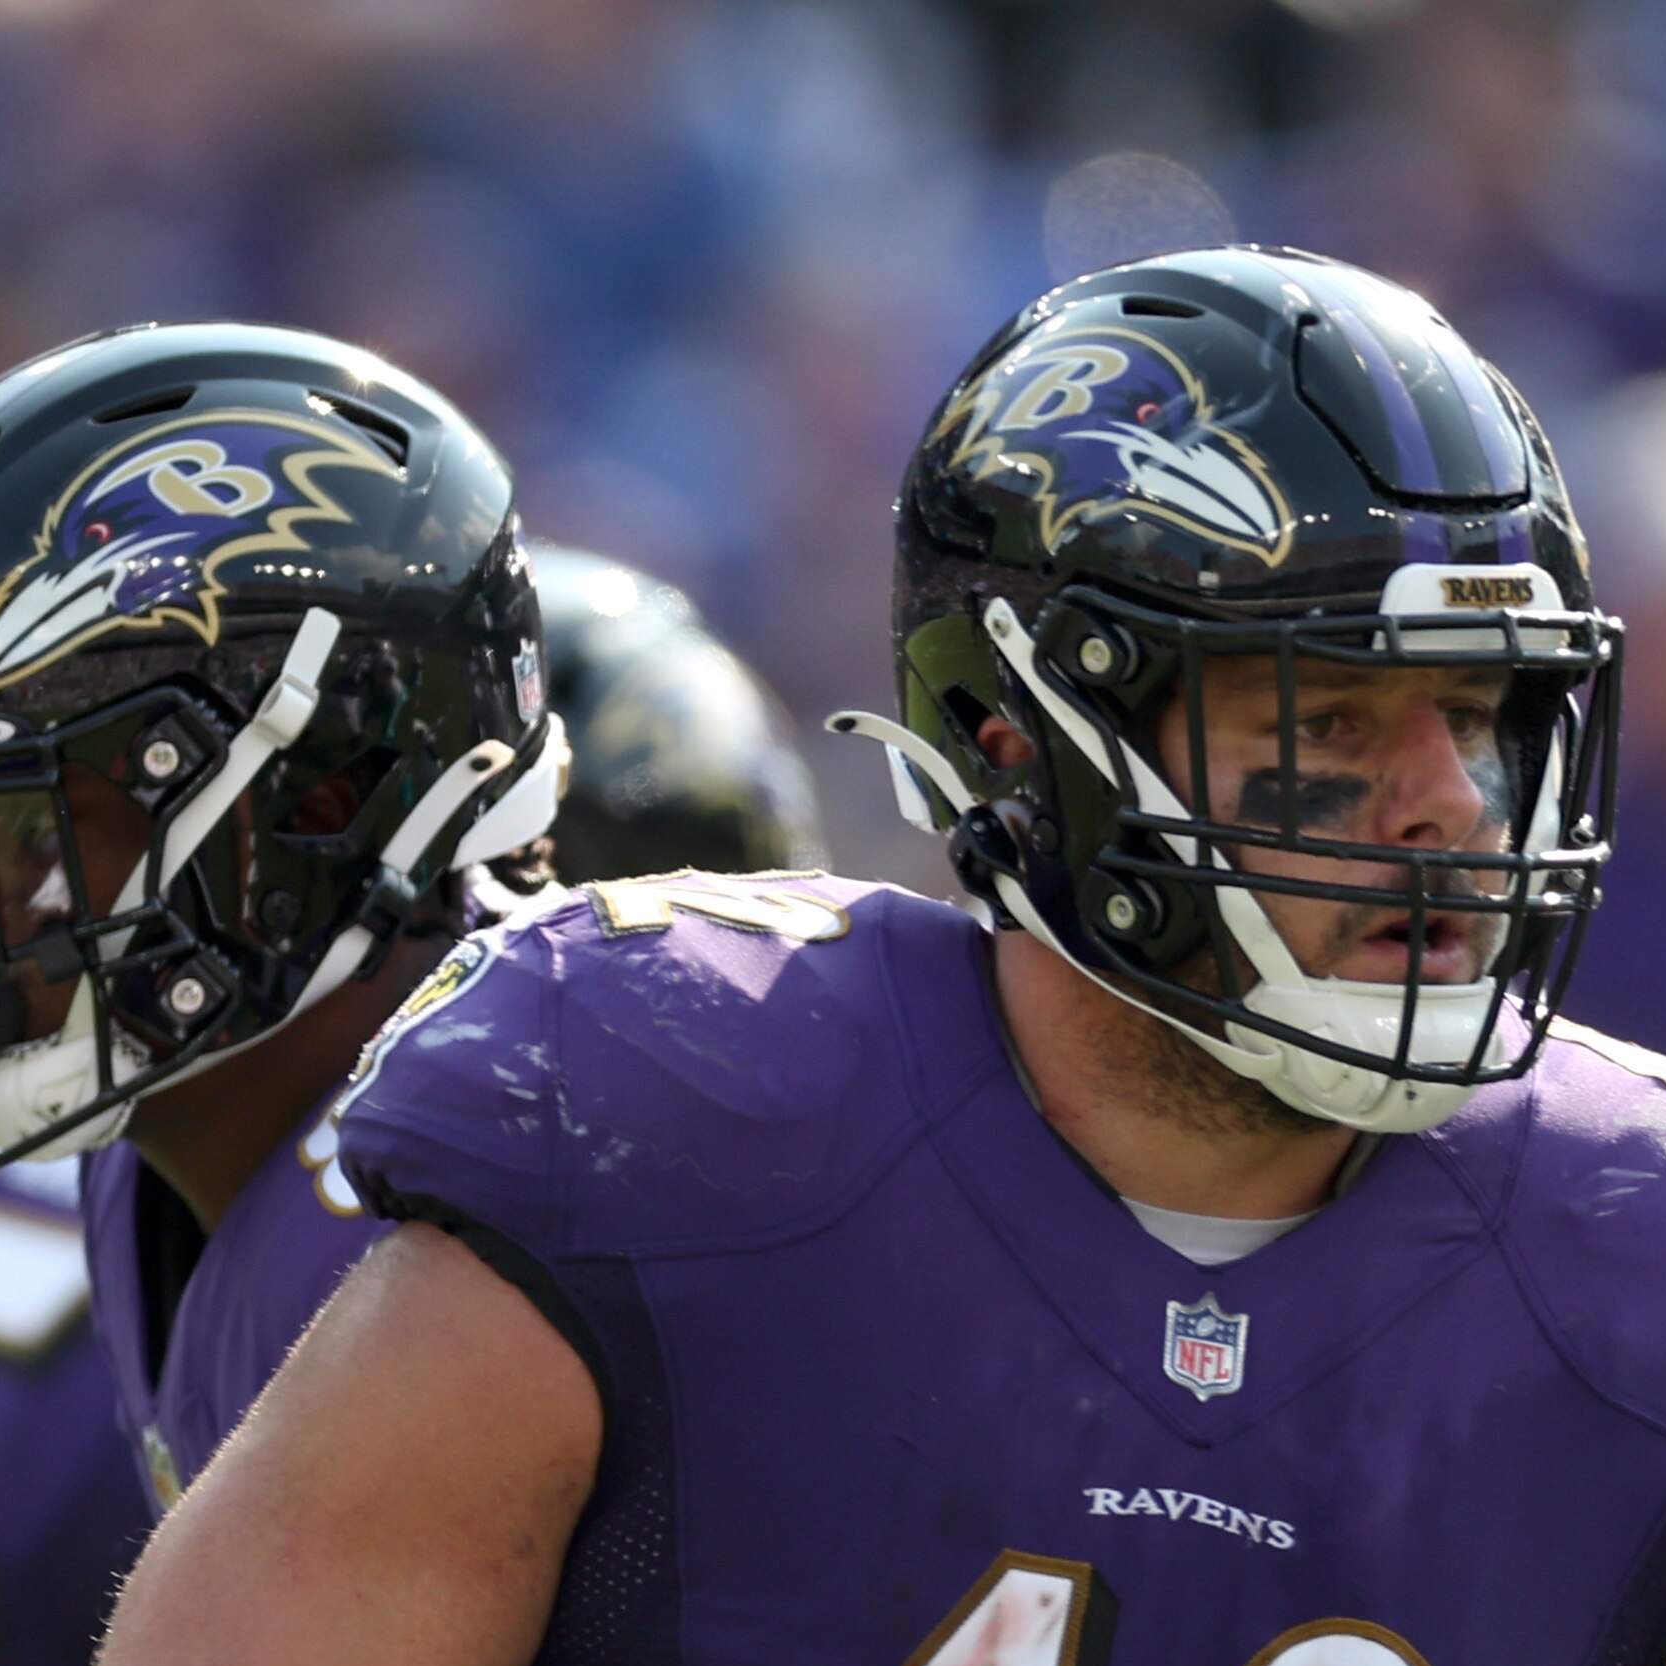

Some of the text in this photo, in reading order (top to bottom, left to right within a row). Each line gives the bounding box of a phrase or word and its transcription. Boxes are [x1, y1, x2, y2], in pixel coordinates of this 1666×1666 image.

[1440, 576, 1534, 609] RAVENS
[1176, 1338, 1232, 1383] NFL
[1082, 1487, 1295, 1550] RAVENS
